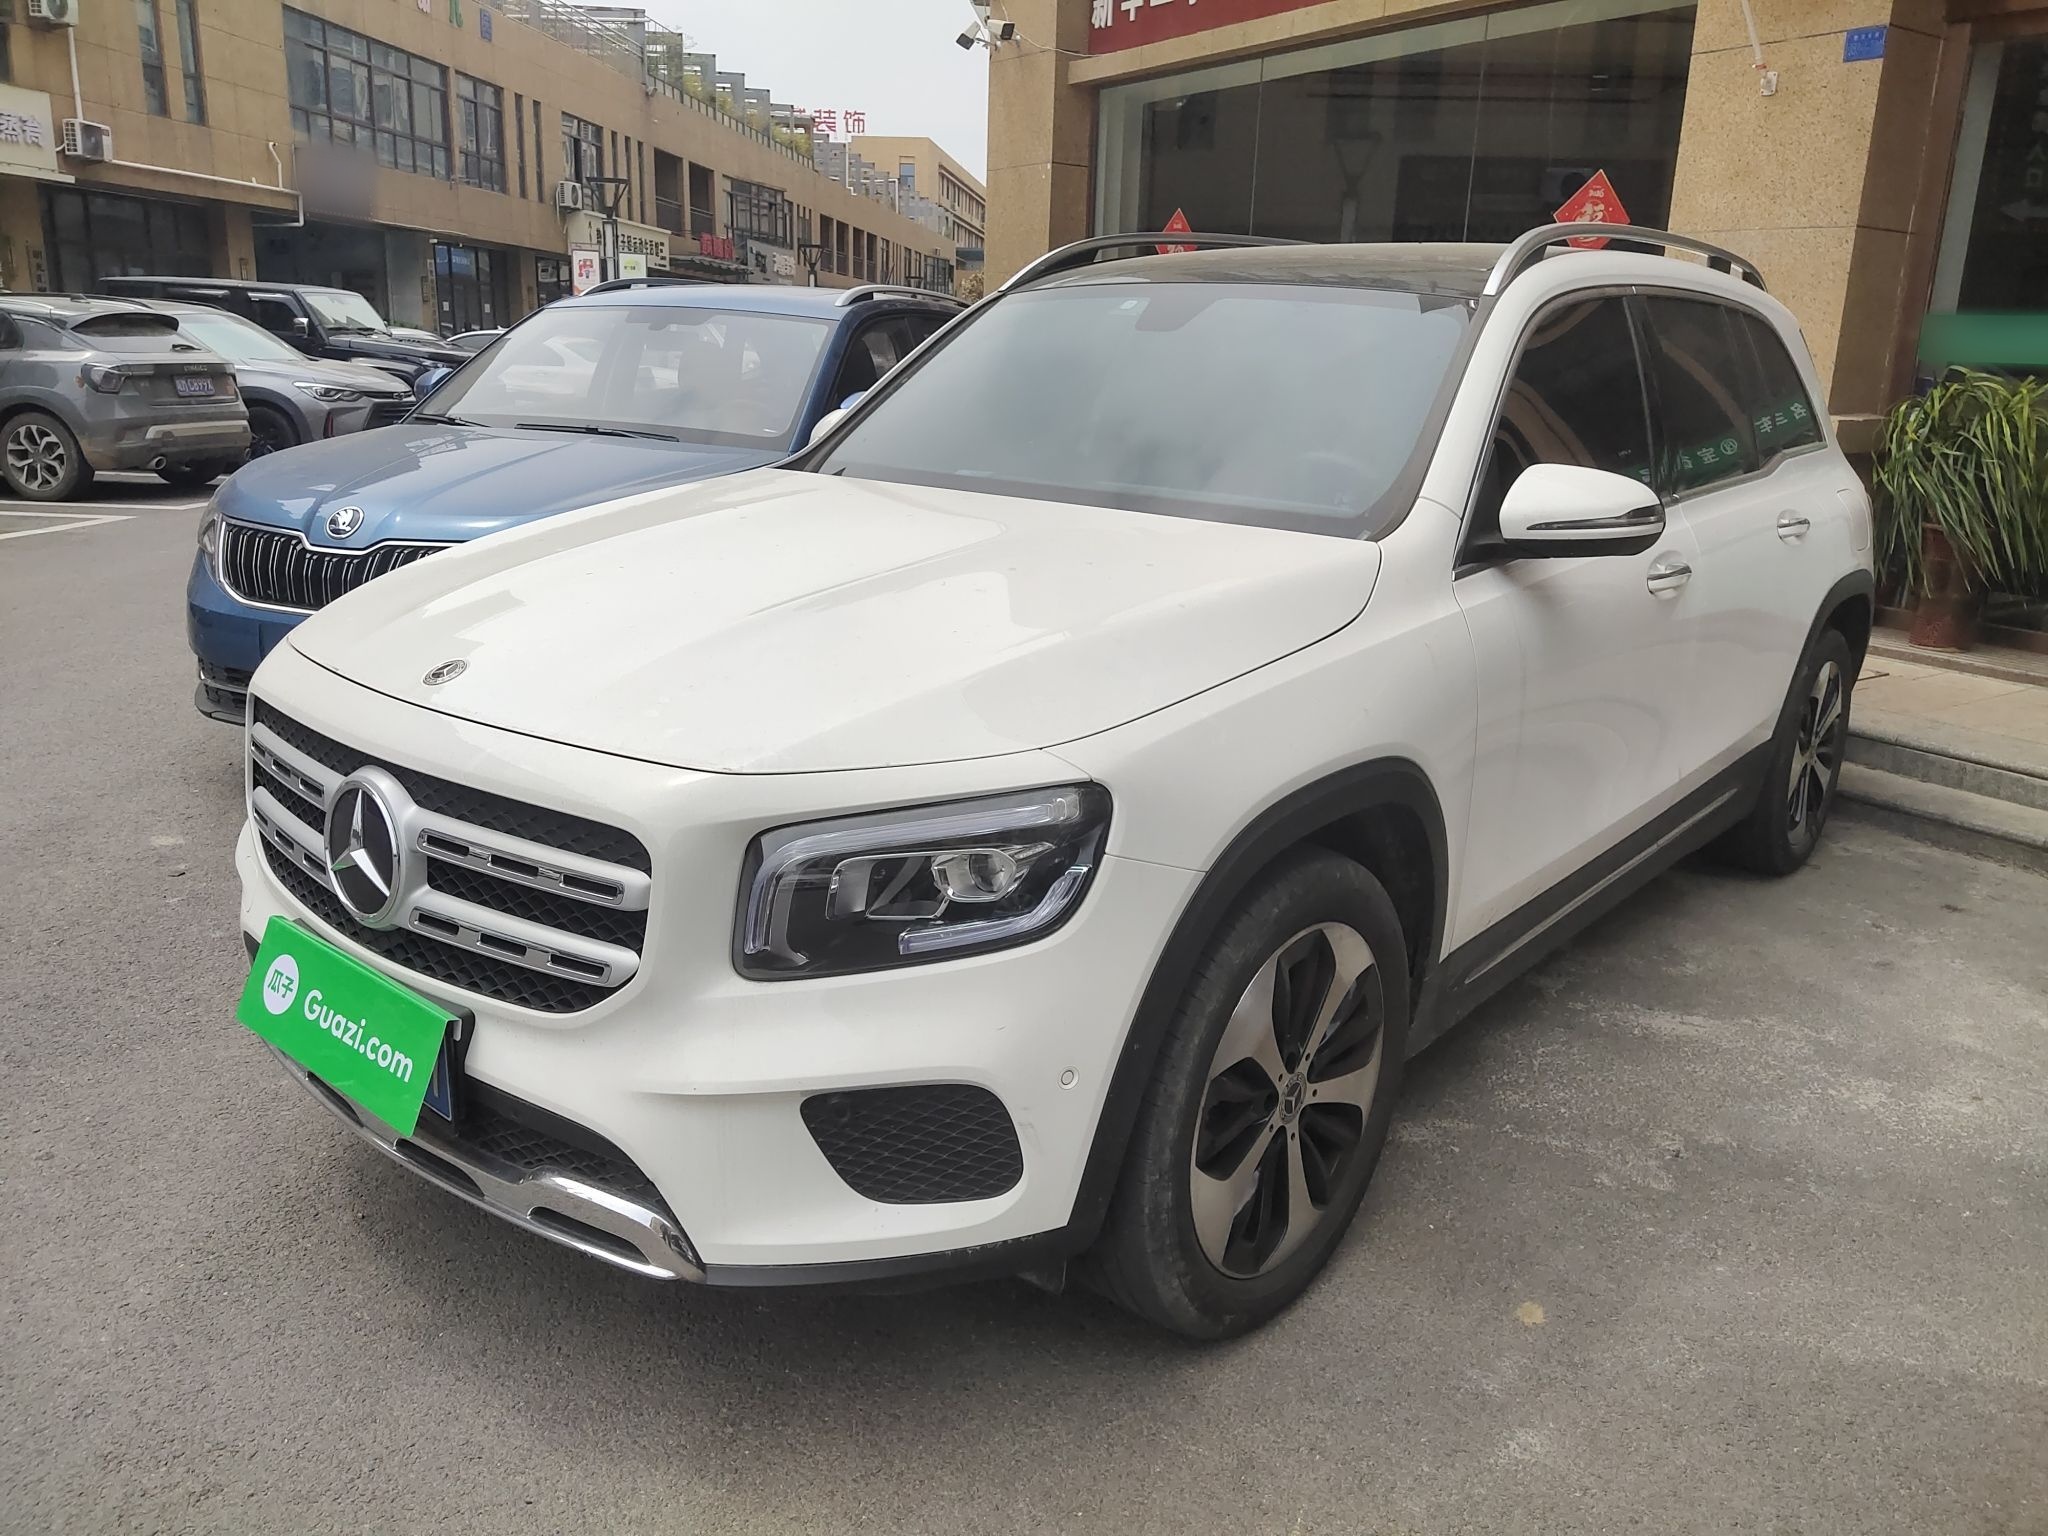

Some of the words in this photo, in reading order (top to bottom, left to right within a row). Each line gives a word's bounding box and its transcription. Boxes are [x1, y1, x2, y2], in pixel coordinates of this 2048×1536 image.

[793, 105, 866, 134] 装饰
[267, 968, 295, 998] 瓜子
[303, 988, 414, 1084] Guazi.com
